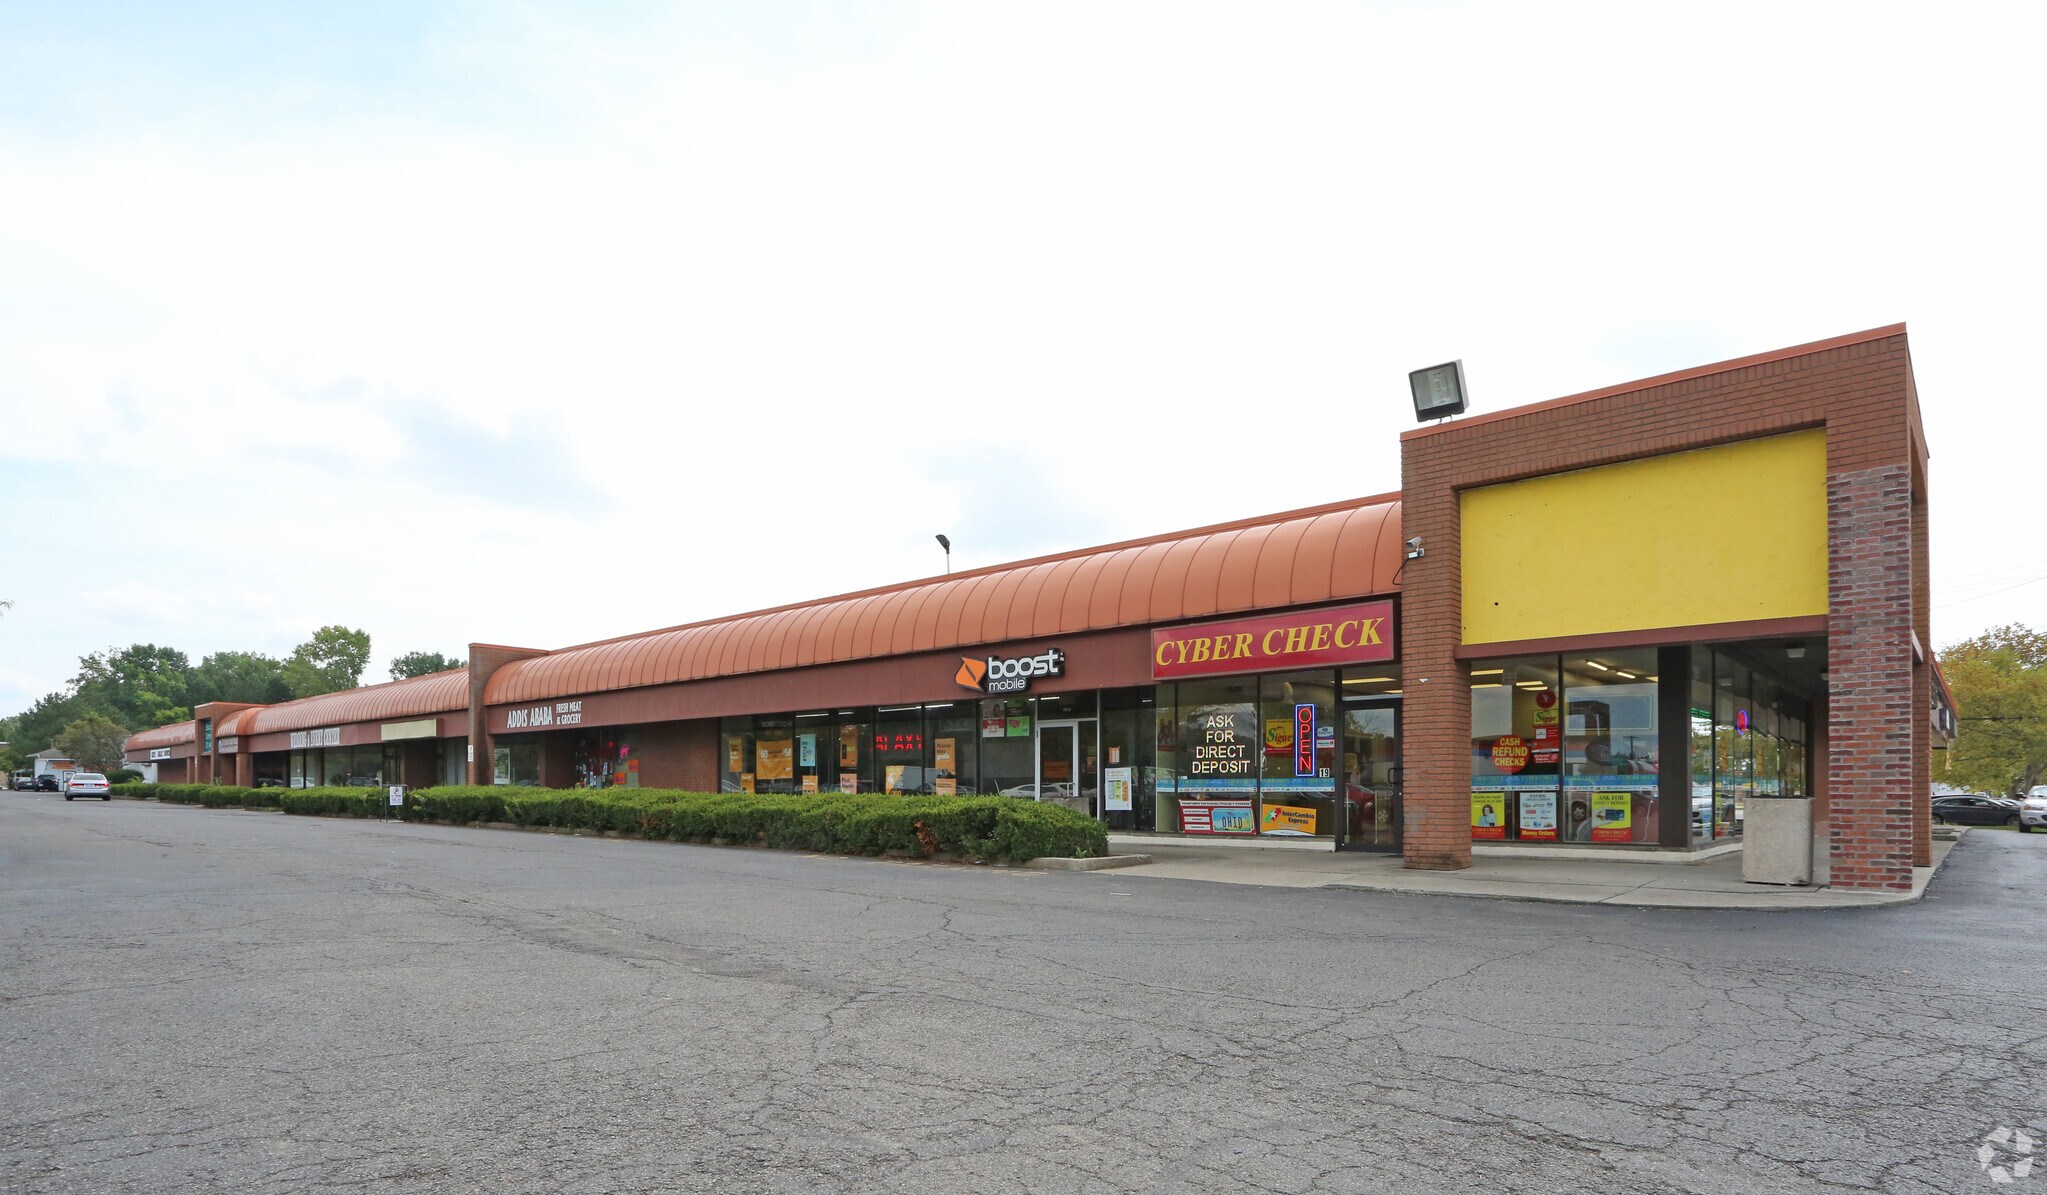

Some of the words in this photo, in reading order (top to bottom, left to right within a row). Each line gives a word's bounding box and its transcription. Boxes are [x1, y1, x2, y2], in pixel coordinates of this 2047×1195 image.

[1155, 633, 1254, 666] CYBER
[1262, 617, 1385, 656] CHECK
[988, 649, 1059, 680] boost
[988, 679, 1026, 692] mobile
[556, 703, 569, 714] FRESH
[569, 701, 582, 712] MEAT
[507, 709, 528, 728] ADDIS
[529, 706, 553, 727] ABABA
[561, 713, 582, 725] GROCERY
[1206, 714, 1234, 729] ASK
[1206, 730, 1235, 743] FOR
[1267, 727, 1293, 744] Sigue
[1298, 708, 1312, 771] OPEN
[1500, 737, 1520, 747] CASH
[1196, 745, 1246, 759] DIRECT
[1492, 746, 1528, 757] REFUND
[1192, 760, 1251, 774] DEPOSIT
[1494, 757, 1525, 767] CHECKS
[1320, 768, 1329, 777] 19
[1221, 816, 1243, 829] OHIO
[1288, 817, 1309, 825] Express
